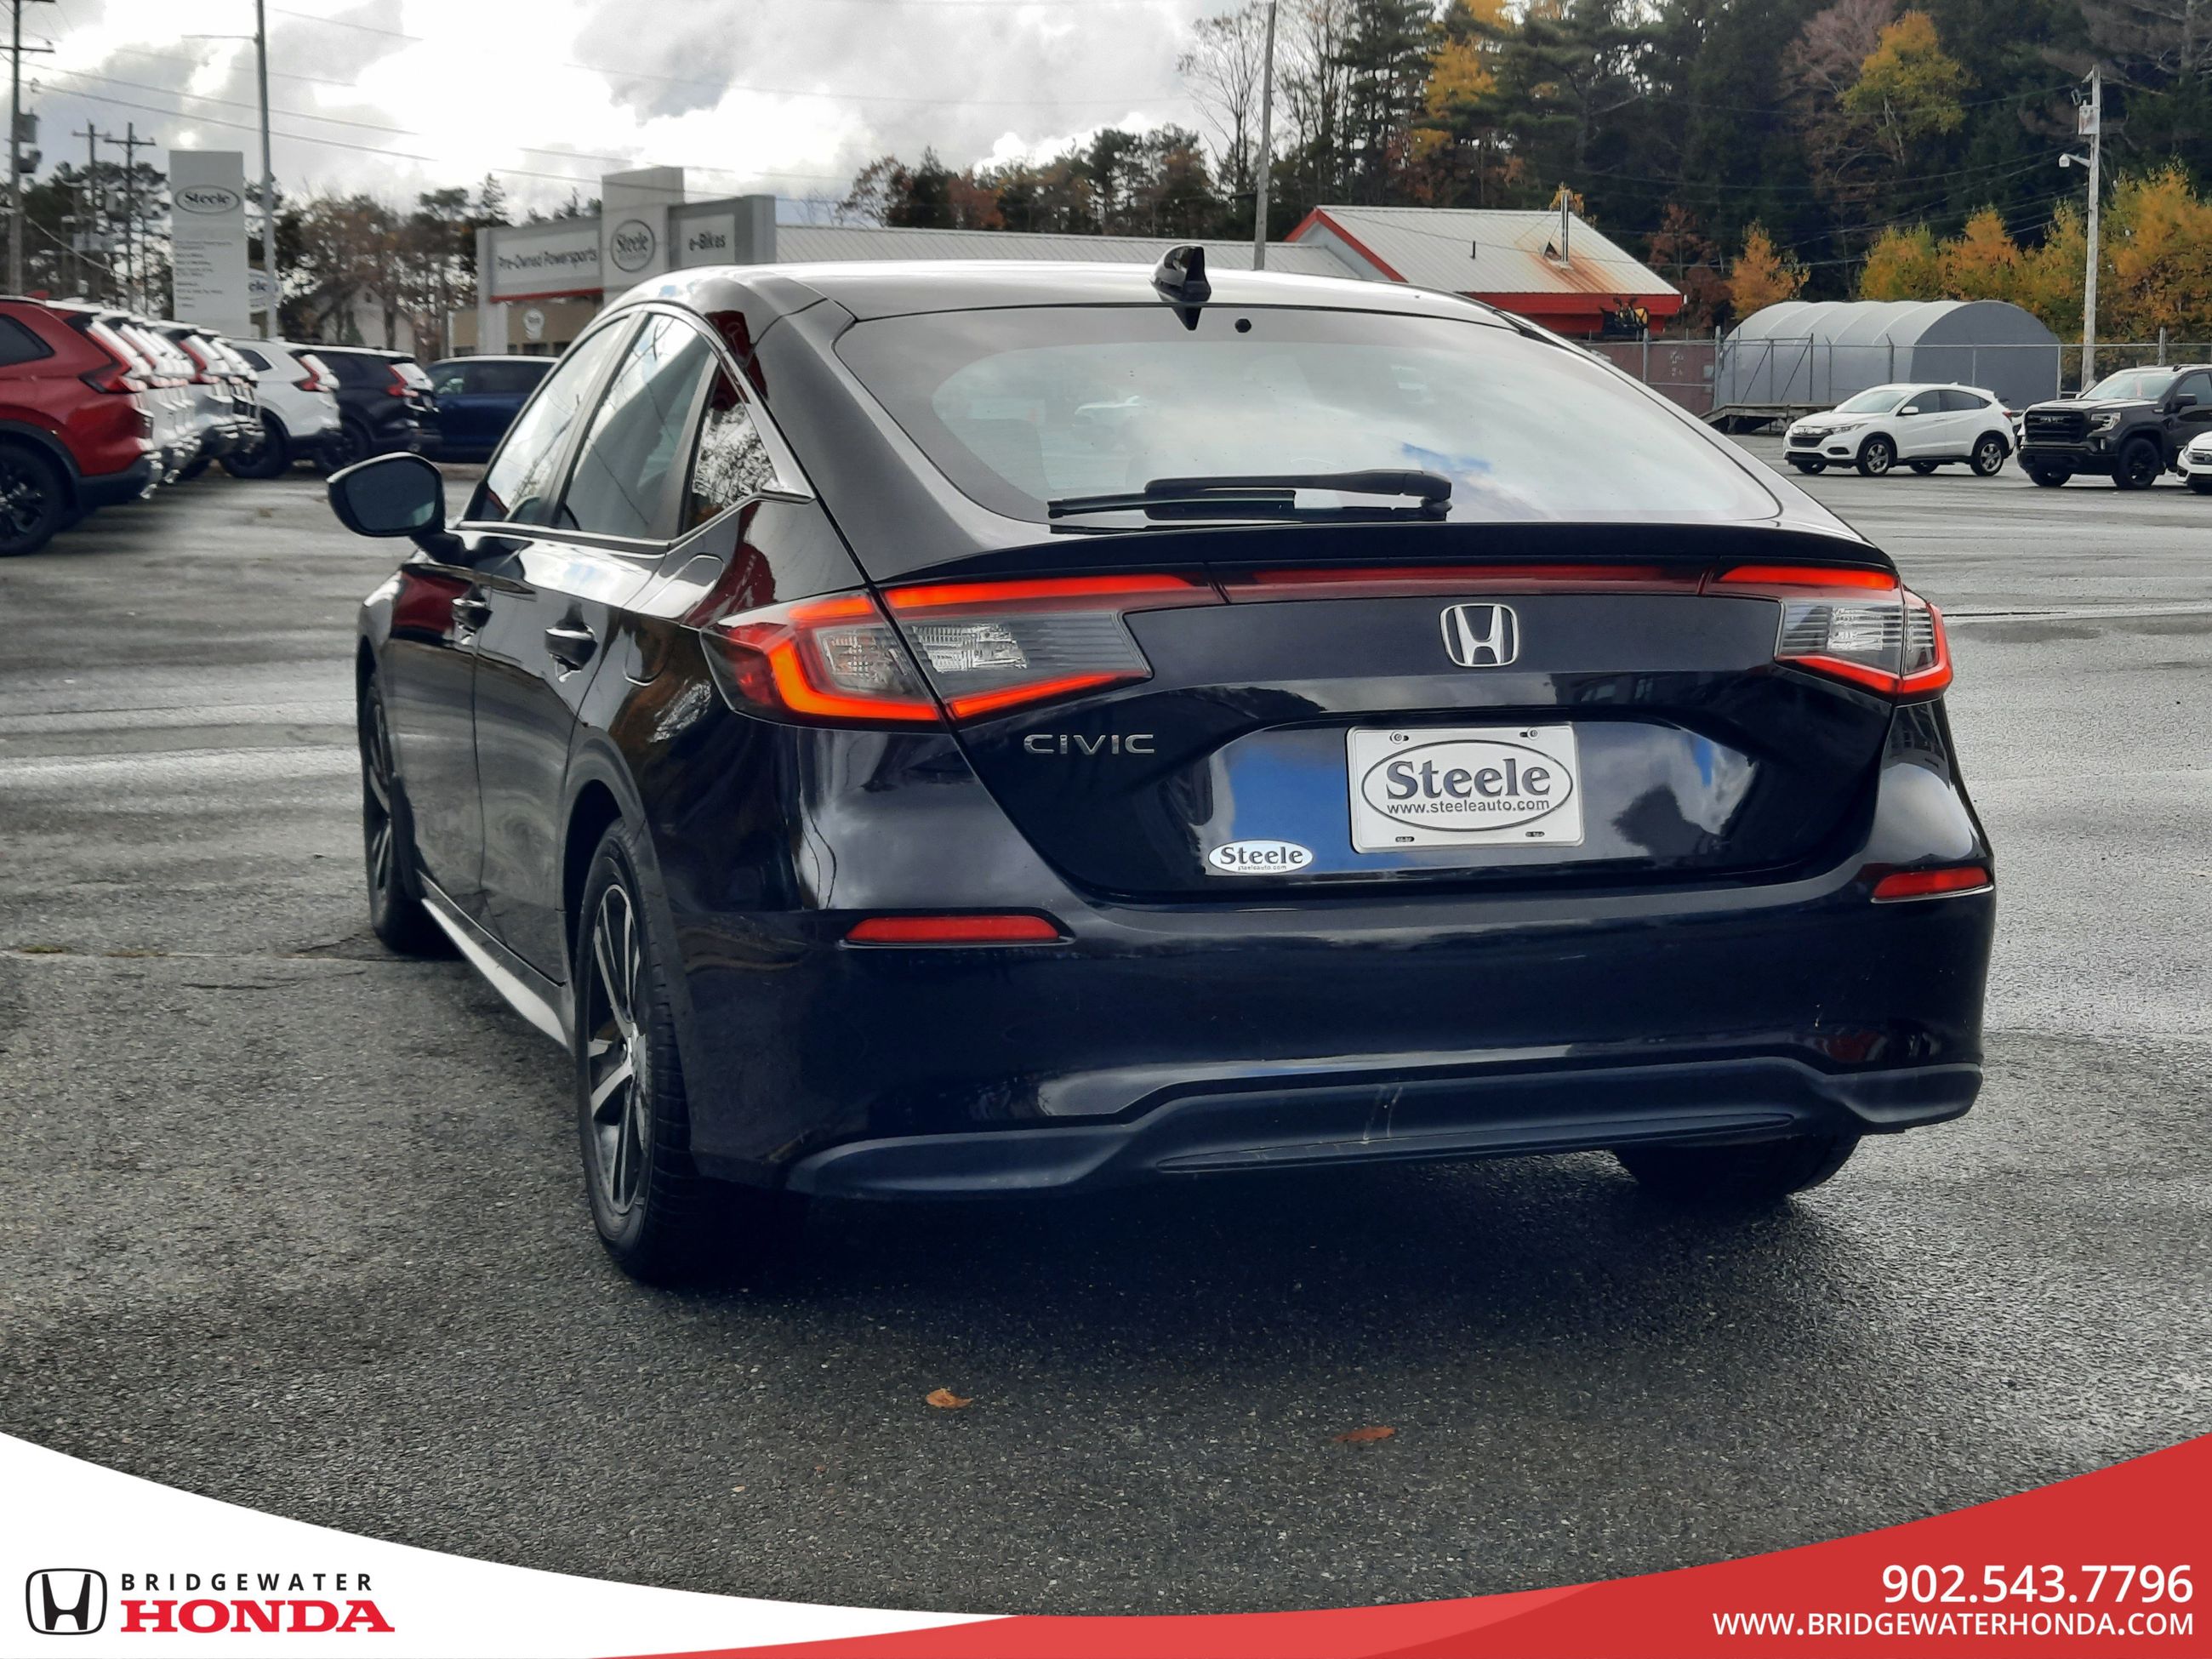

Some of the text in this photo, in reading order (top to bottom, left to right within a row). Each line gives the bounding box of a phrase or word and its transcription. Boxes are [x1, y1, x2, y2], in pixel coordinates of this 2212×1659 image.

[185, 191, 231, 205] Steele
[1023, 733, 1155, 755] CIVIC
[1386, 757, 1551, 800] Steele
[1387, 800, 1550, 814] www.steeleauto.com
[1220, 847, 1303, 865] Steele
